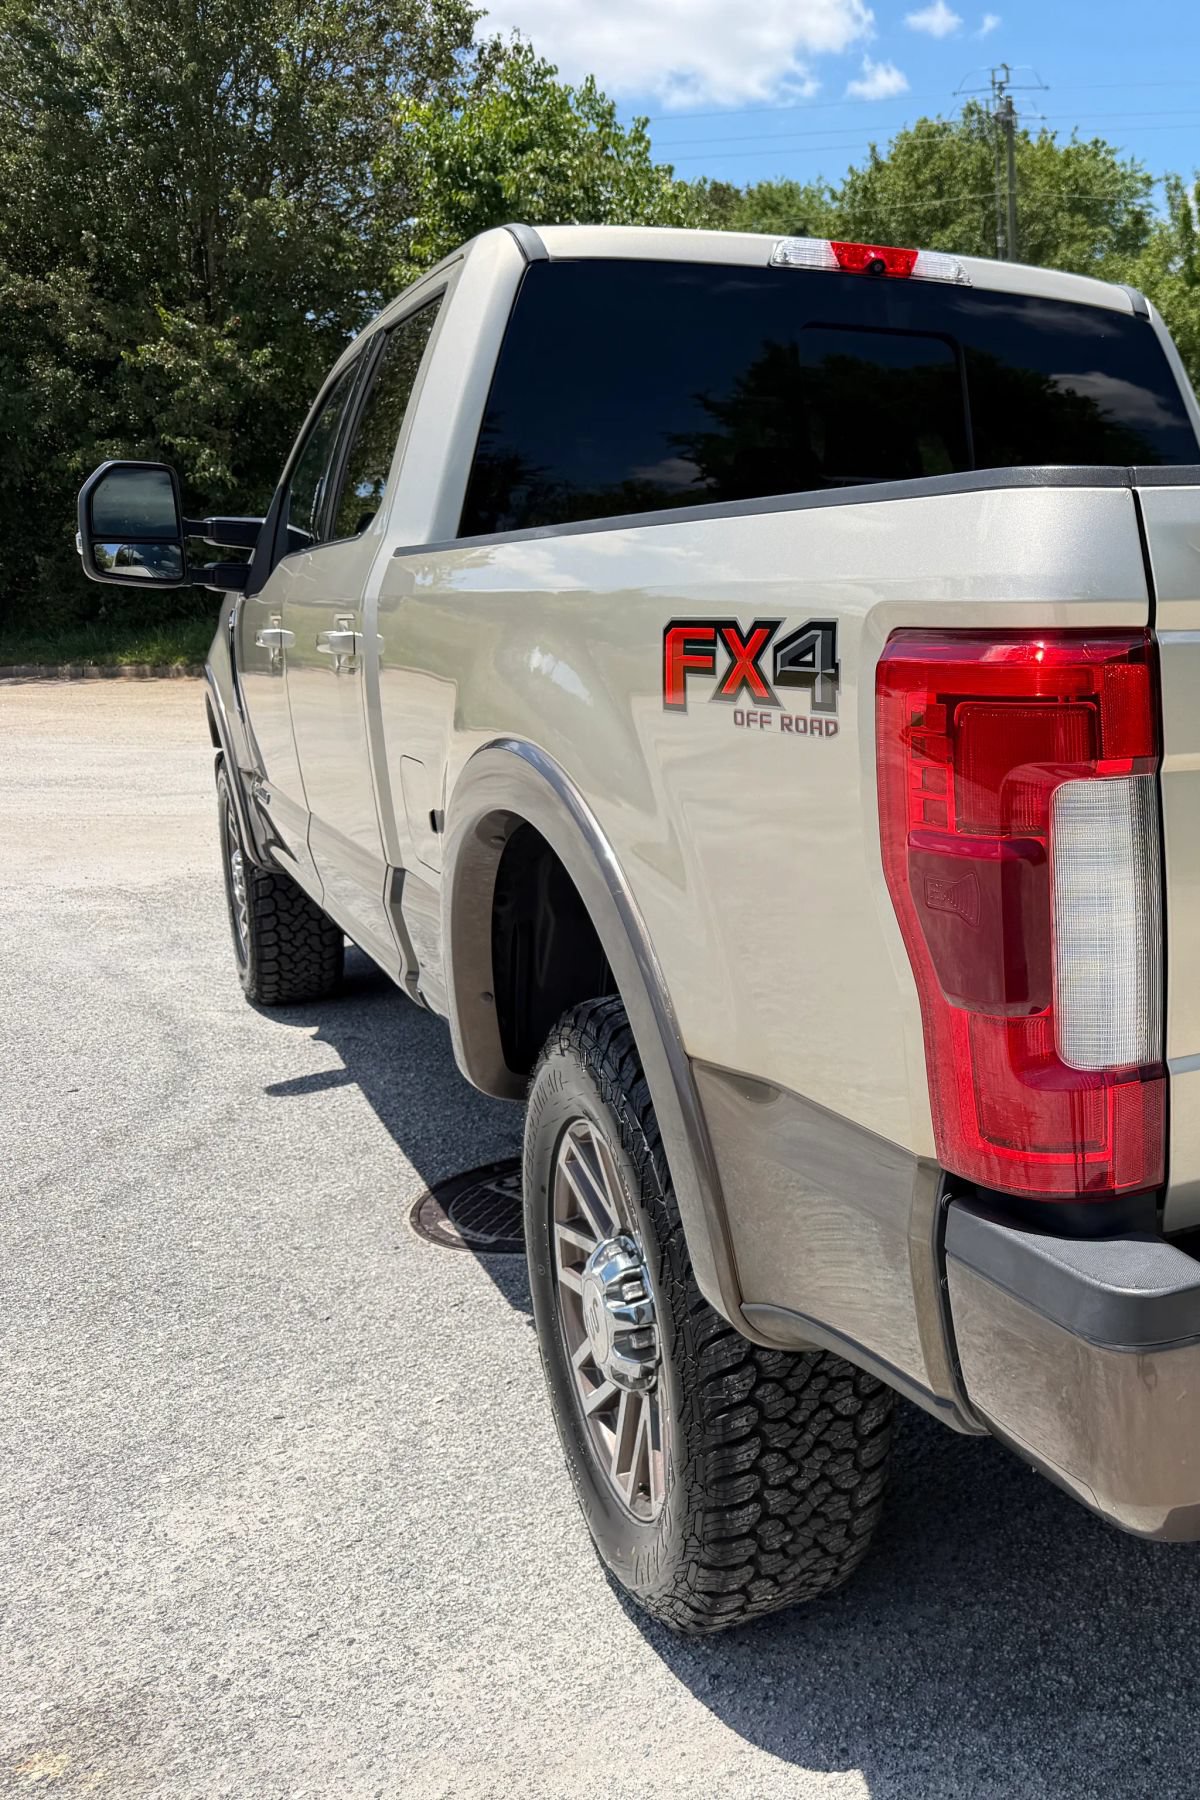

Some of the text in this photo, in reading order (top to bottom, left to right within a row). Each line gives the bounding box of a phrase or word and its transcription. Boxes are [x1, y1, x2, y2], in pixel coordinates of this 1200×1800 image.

[663, 616, 842, 716] FX4
[733, 709, 839, 738] OFF ROAD
